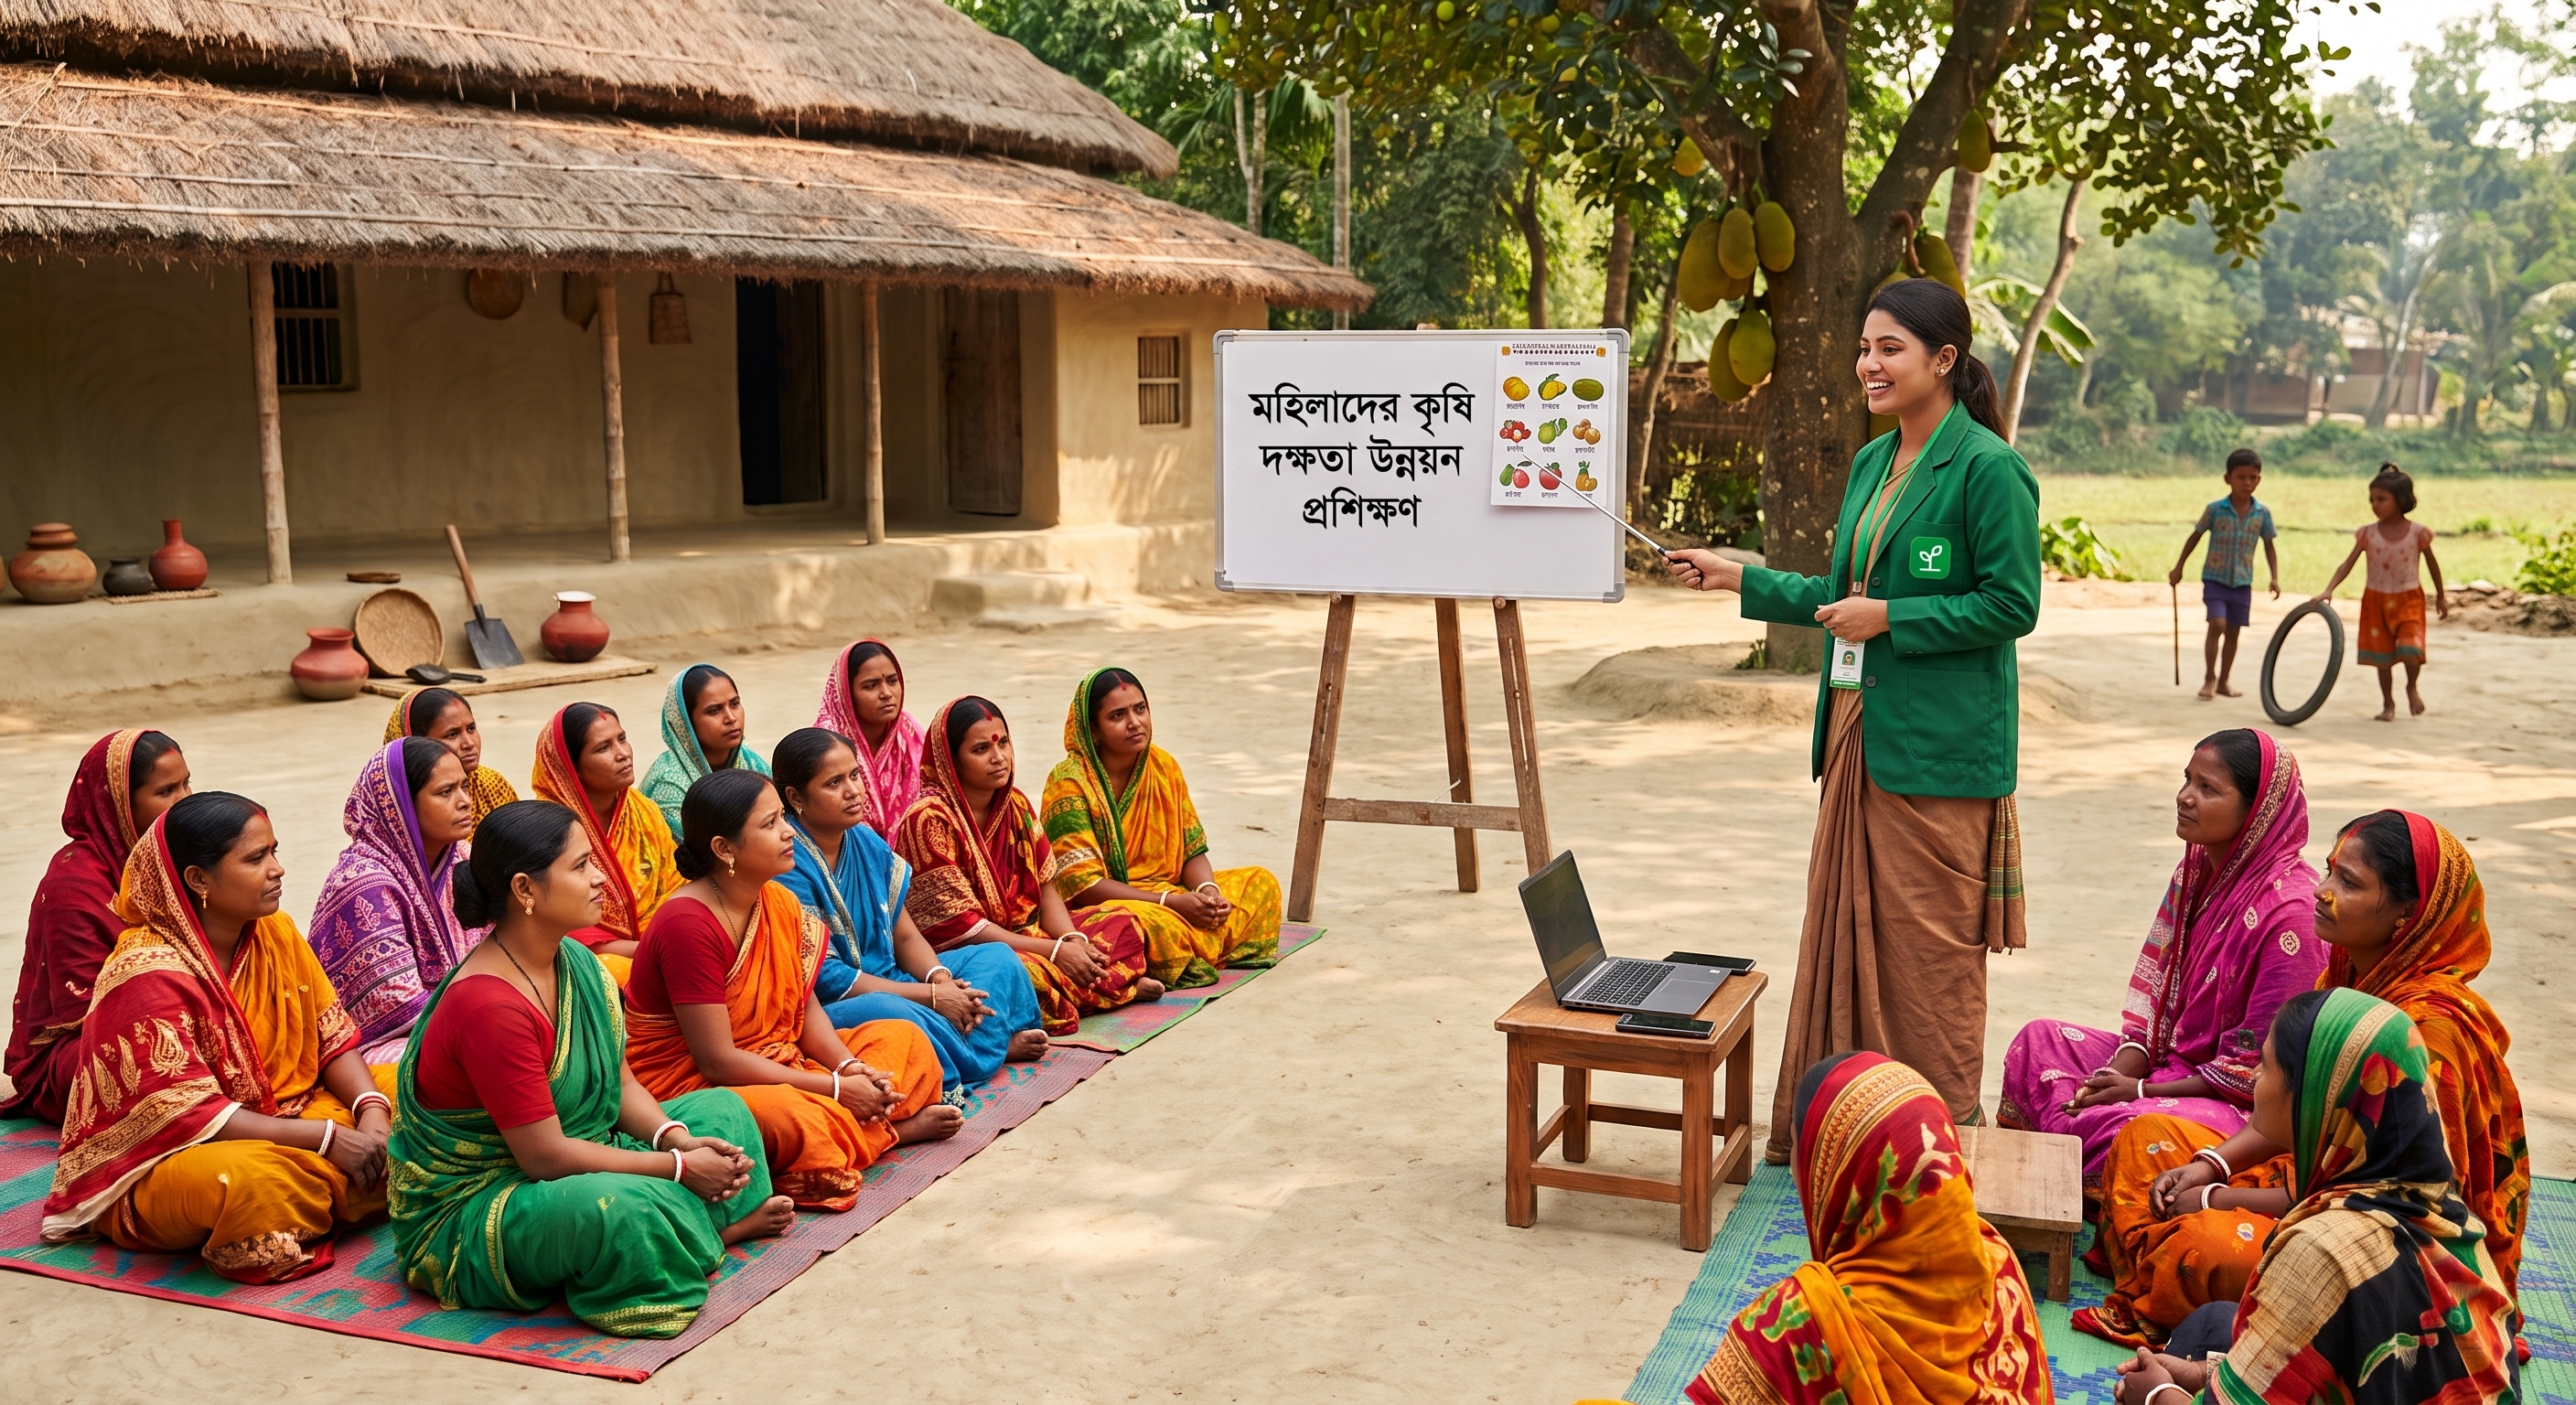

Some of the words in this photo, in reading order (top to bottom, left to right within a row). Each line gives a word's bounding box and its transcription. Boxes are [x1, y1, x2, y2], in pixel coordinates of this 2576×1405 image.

[1247, 381, 1402, 428] মহিলাদের
[1410, 381, 1476, 437] কৃষি
[1258, 441, 1358, 477] দক্ষতা
[1366, 434, 1465, 482] উন্নয়ন
[1302, 486, 1422, 530] প্রশিক্ষণ
